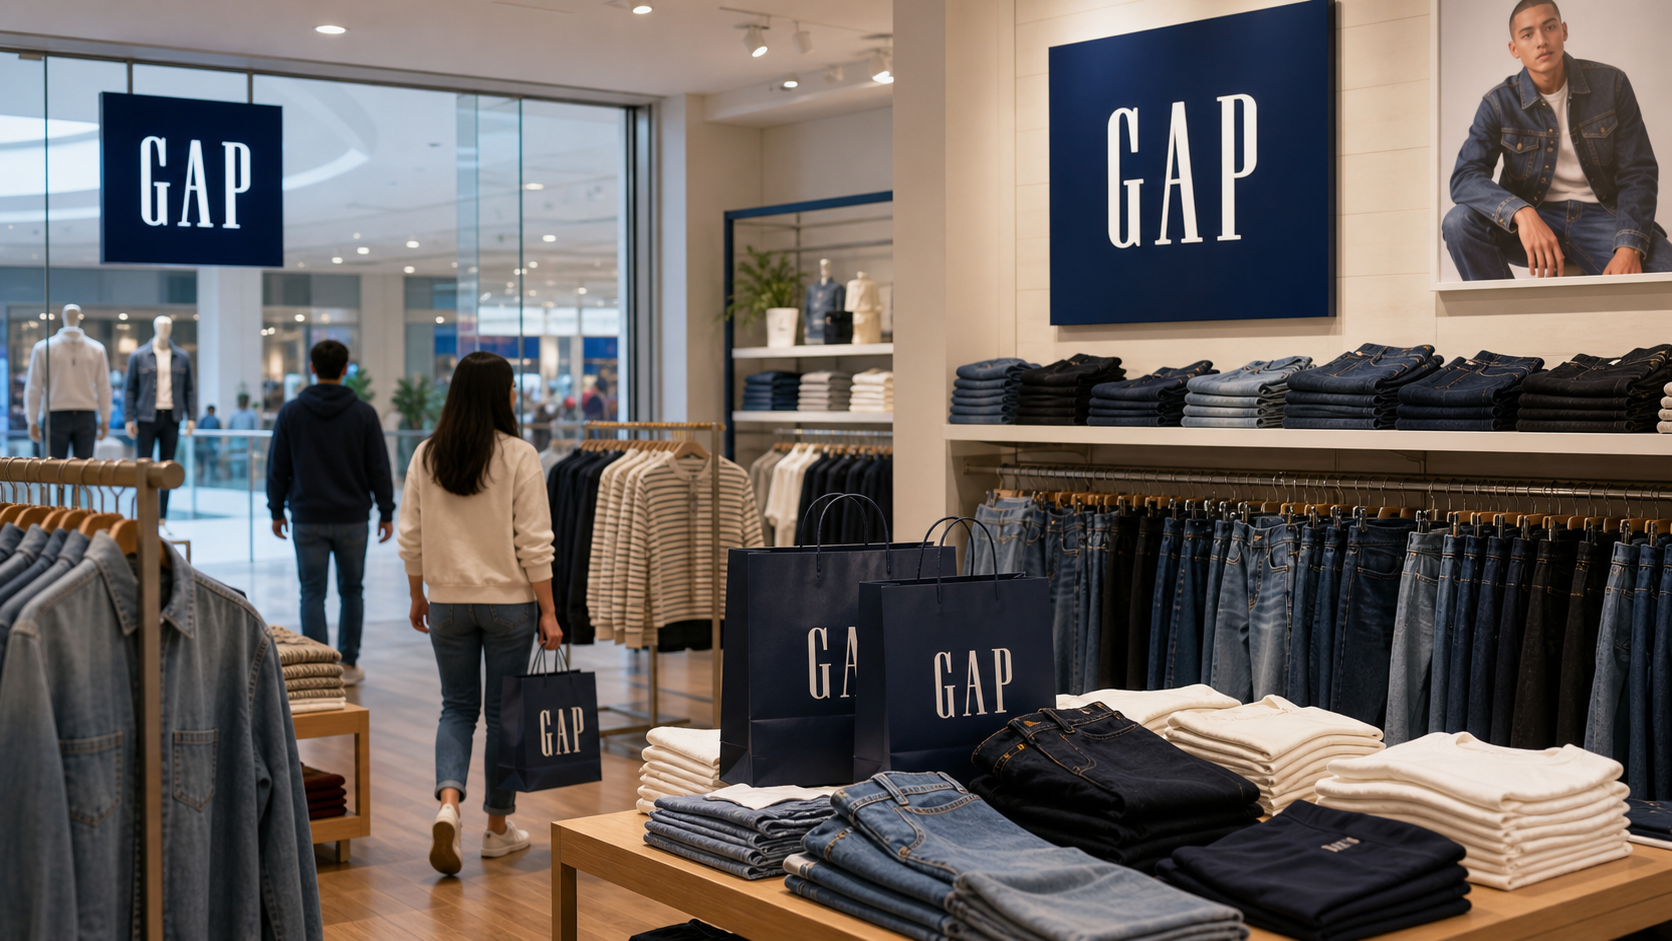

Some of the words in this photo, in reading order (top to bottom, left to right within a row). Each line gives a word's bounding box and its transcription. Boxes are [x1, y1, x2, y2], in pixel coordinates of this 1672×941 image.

[140, 135, 251, 229] GAP
[1108, 93, 1258, 249] GAP
[934, 647, 1014, 720] GAP
[539, 706, 584, 757] GAP
